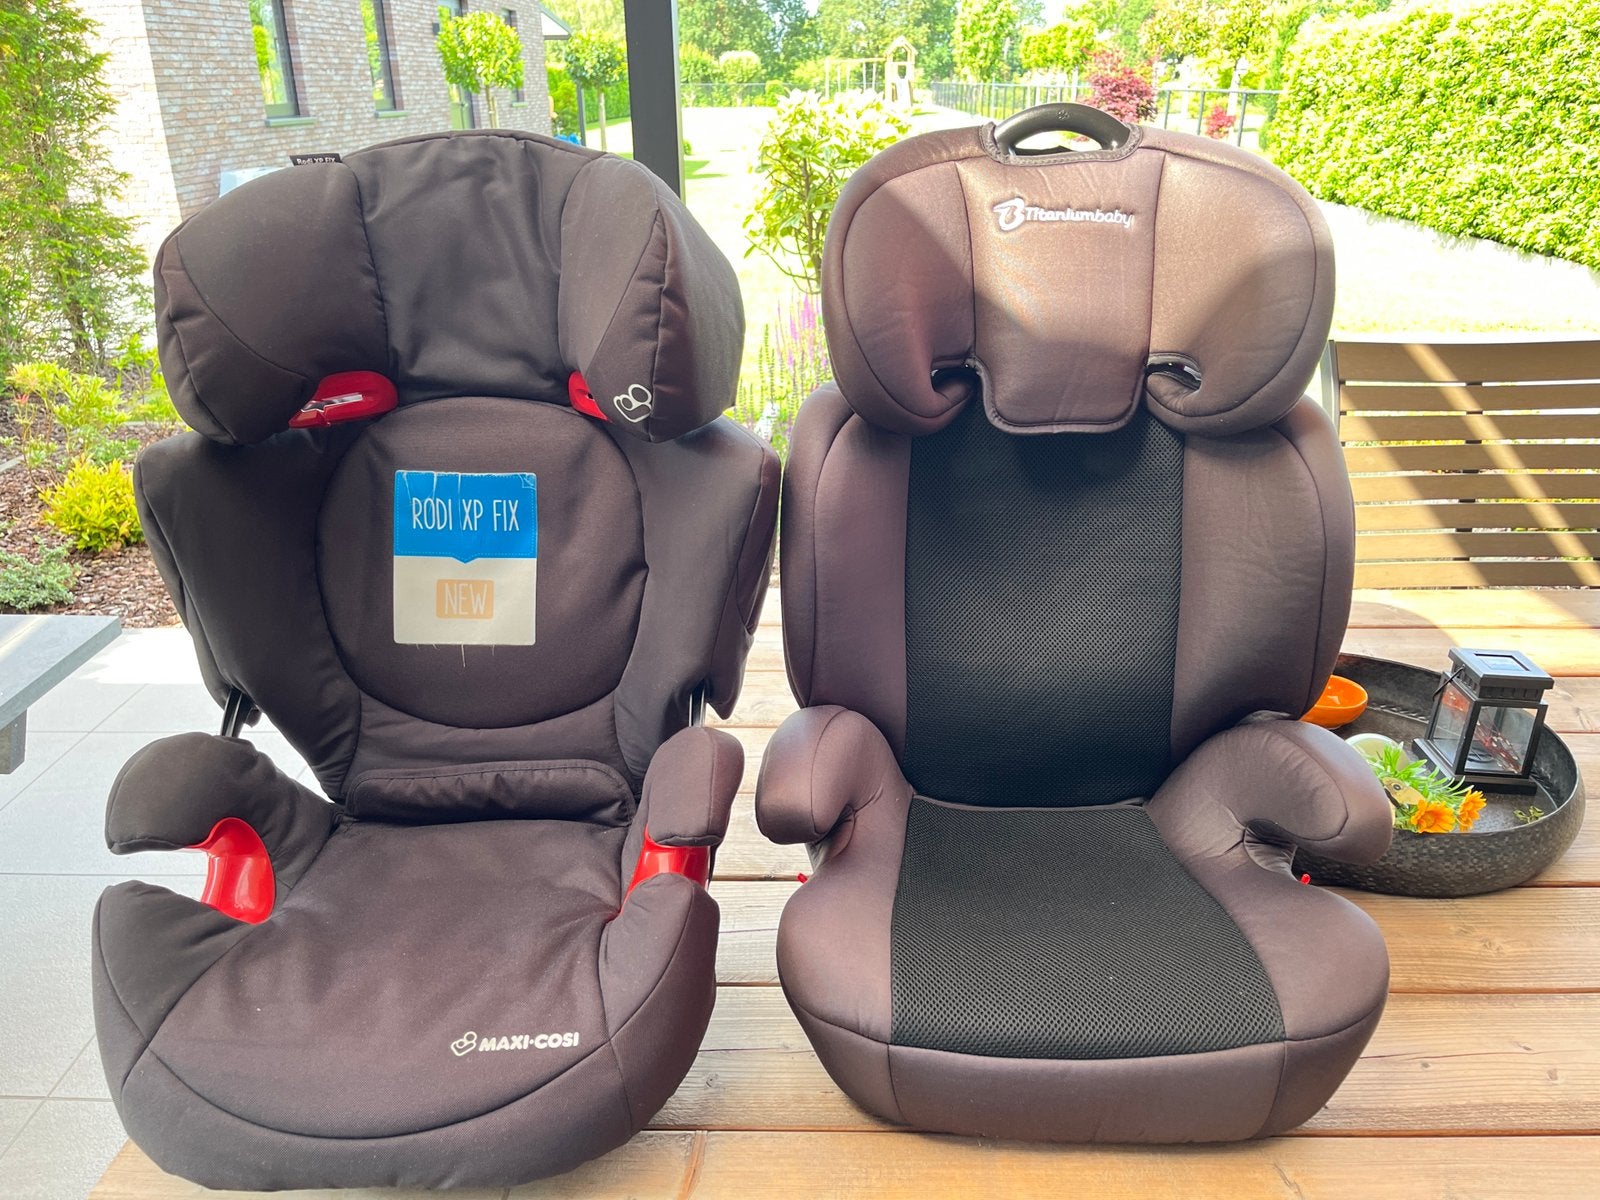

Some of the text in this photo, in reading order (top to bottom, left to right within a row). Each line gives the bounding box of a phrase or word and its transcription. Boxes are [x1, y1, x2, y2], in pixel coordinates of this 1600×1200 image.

[1025, 207, 1133, 228] Titaniumbaby
[412, 497, 520, 531] RODI XP FIX
[444, 582, 488, 615] NEW
